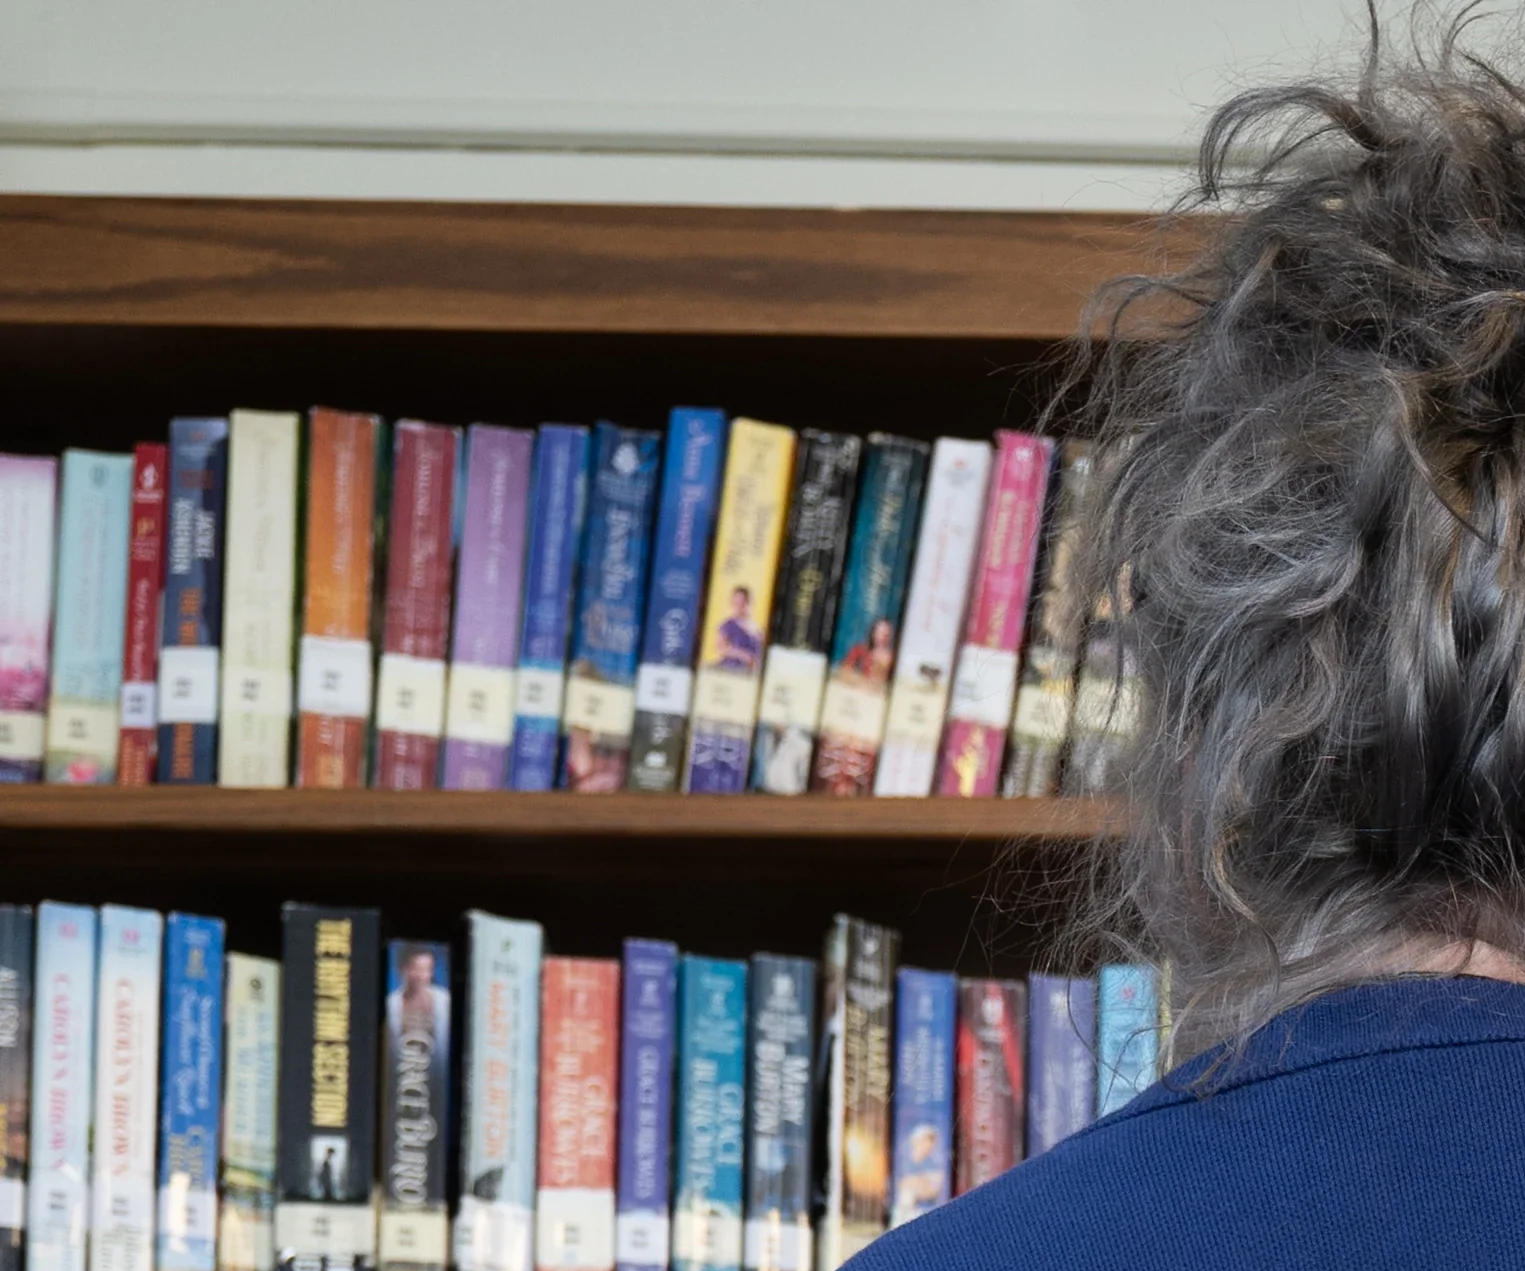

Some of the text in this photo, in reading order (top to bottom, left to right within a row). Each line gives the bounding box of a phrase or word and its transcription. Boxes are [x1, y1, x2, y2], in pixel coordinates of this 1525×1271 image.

[312, 920, 351, 1127] THE RHYTHM SECTION
[395, 1031, 437, 1206] GRACE BURRO
